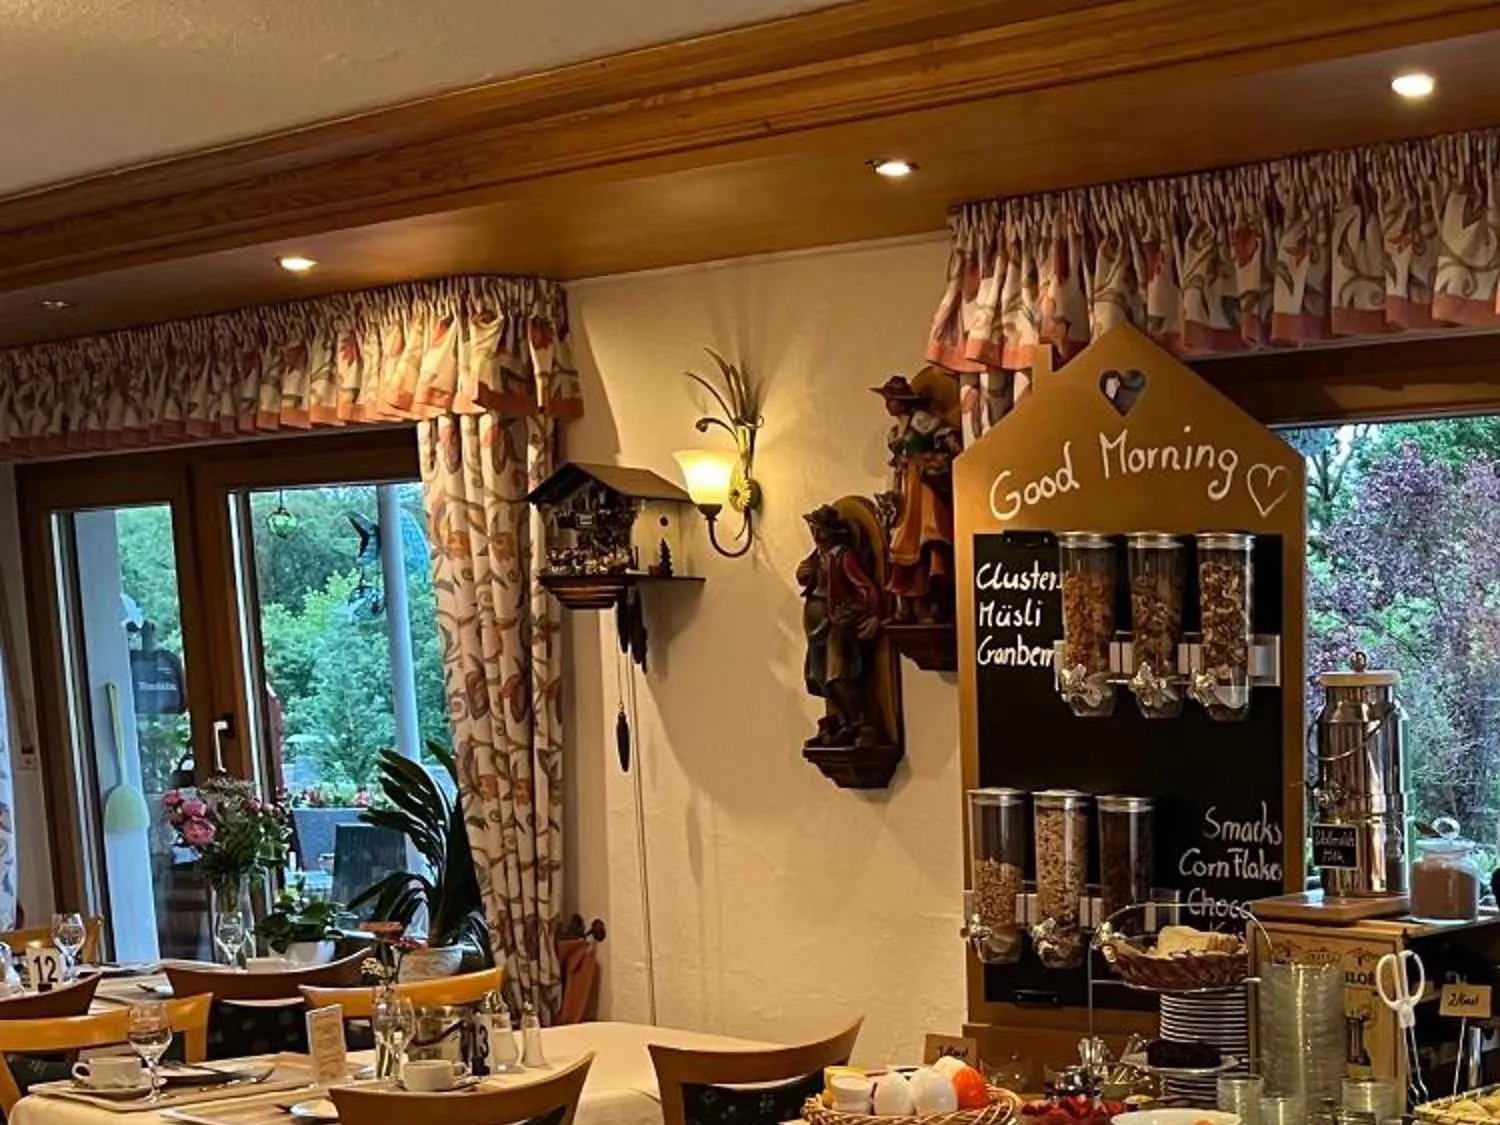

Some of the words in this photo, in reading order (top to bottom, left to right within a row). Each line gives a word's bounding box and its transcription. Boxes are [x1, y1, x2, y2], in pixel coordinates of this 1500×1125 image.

[989, 440, 1081, 521] Good
[1099, 425, 1239, 500] Morning
[976, 560, 1062, 592] Cluster
[979, 598, 1043, 627] Müsli
[978, 633, 1054, 667] Cranberr
[1202, 800, 1283, 845] Smacks
[34, 955, 58, 983] 12
